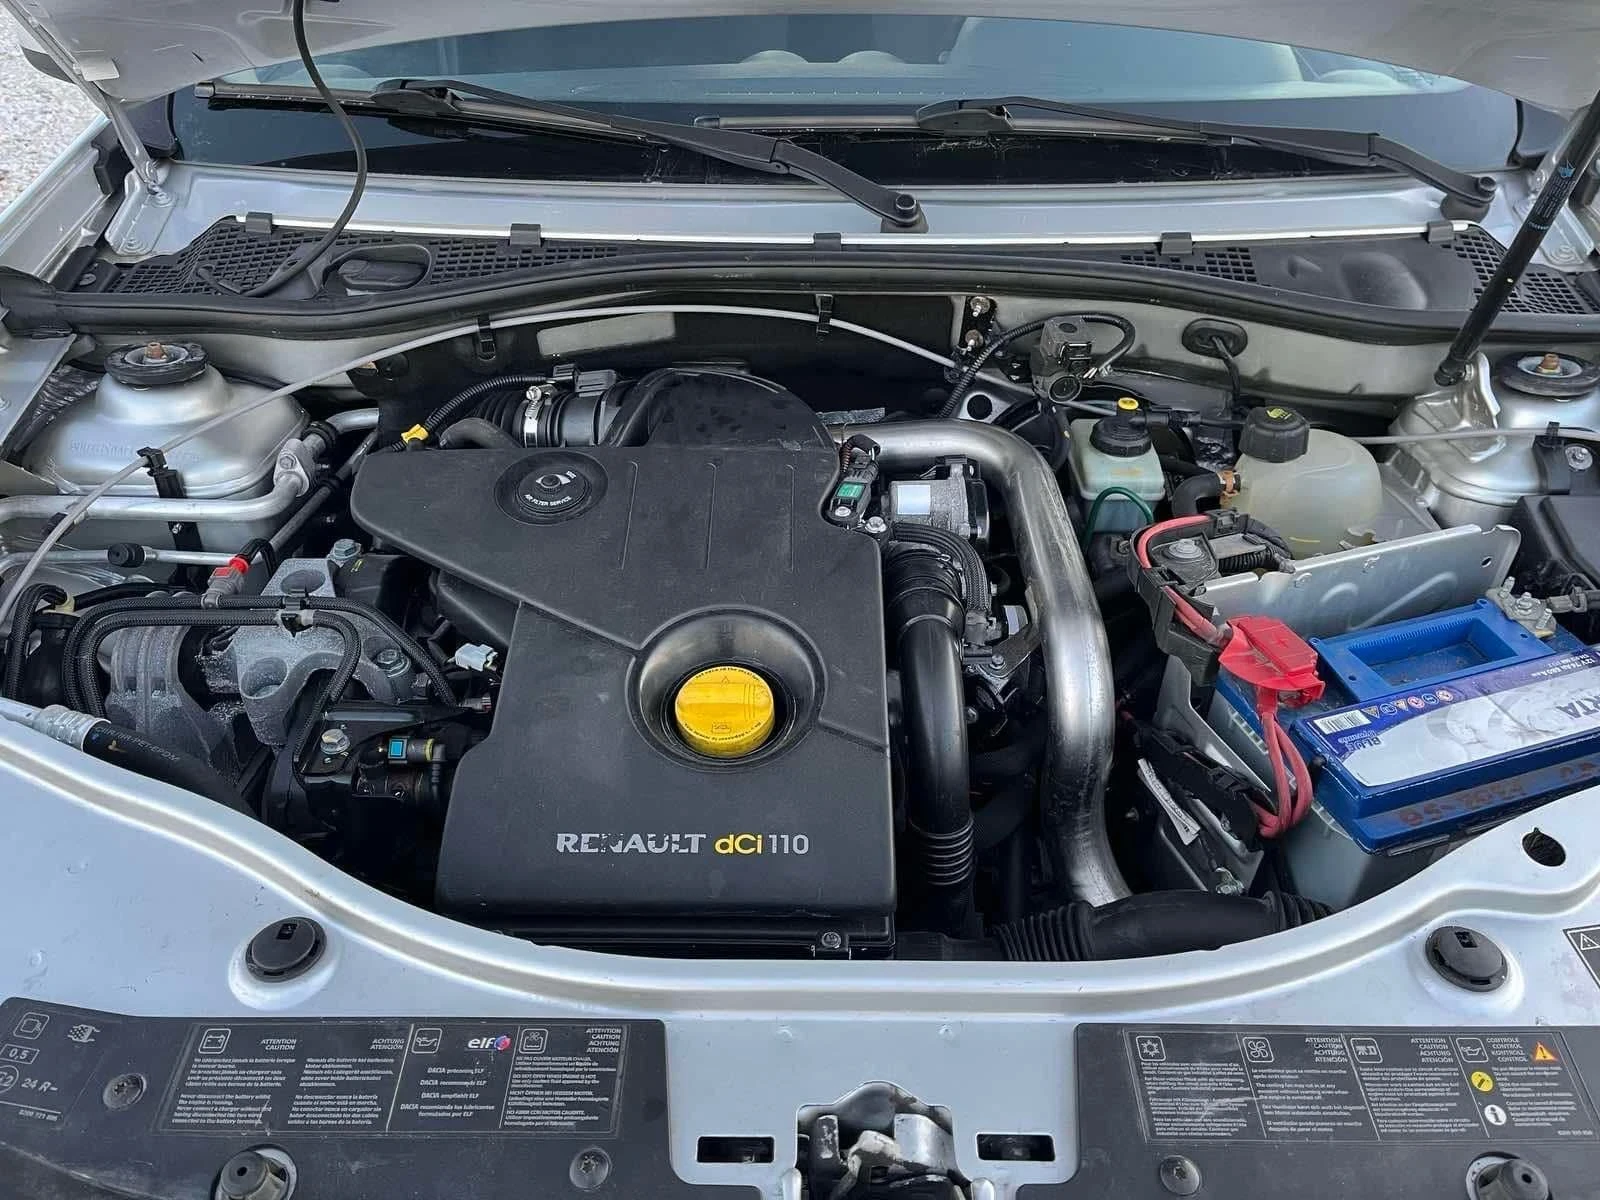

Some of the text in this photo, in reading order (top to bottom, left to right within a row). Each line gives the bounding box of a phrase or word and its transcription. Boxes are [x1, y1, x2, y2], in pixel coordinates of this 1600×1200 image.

[1345, 736, 1382, 752] BLUE
[556, 833, 809, 855] RENAULT dCi 110
[467, 1036, 496, 1049] elf
[9, 1048, 30, 1060] 0,5
[21, 1078, 38, 1089] 24
